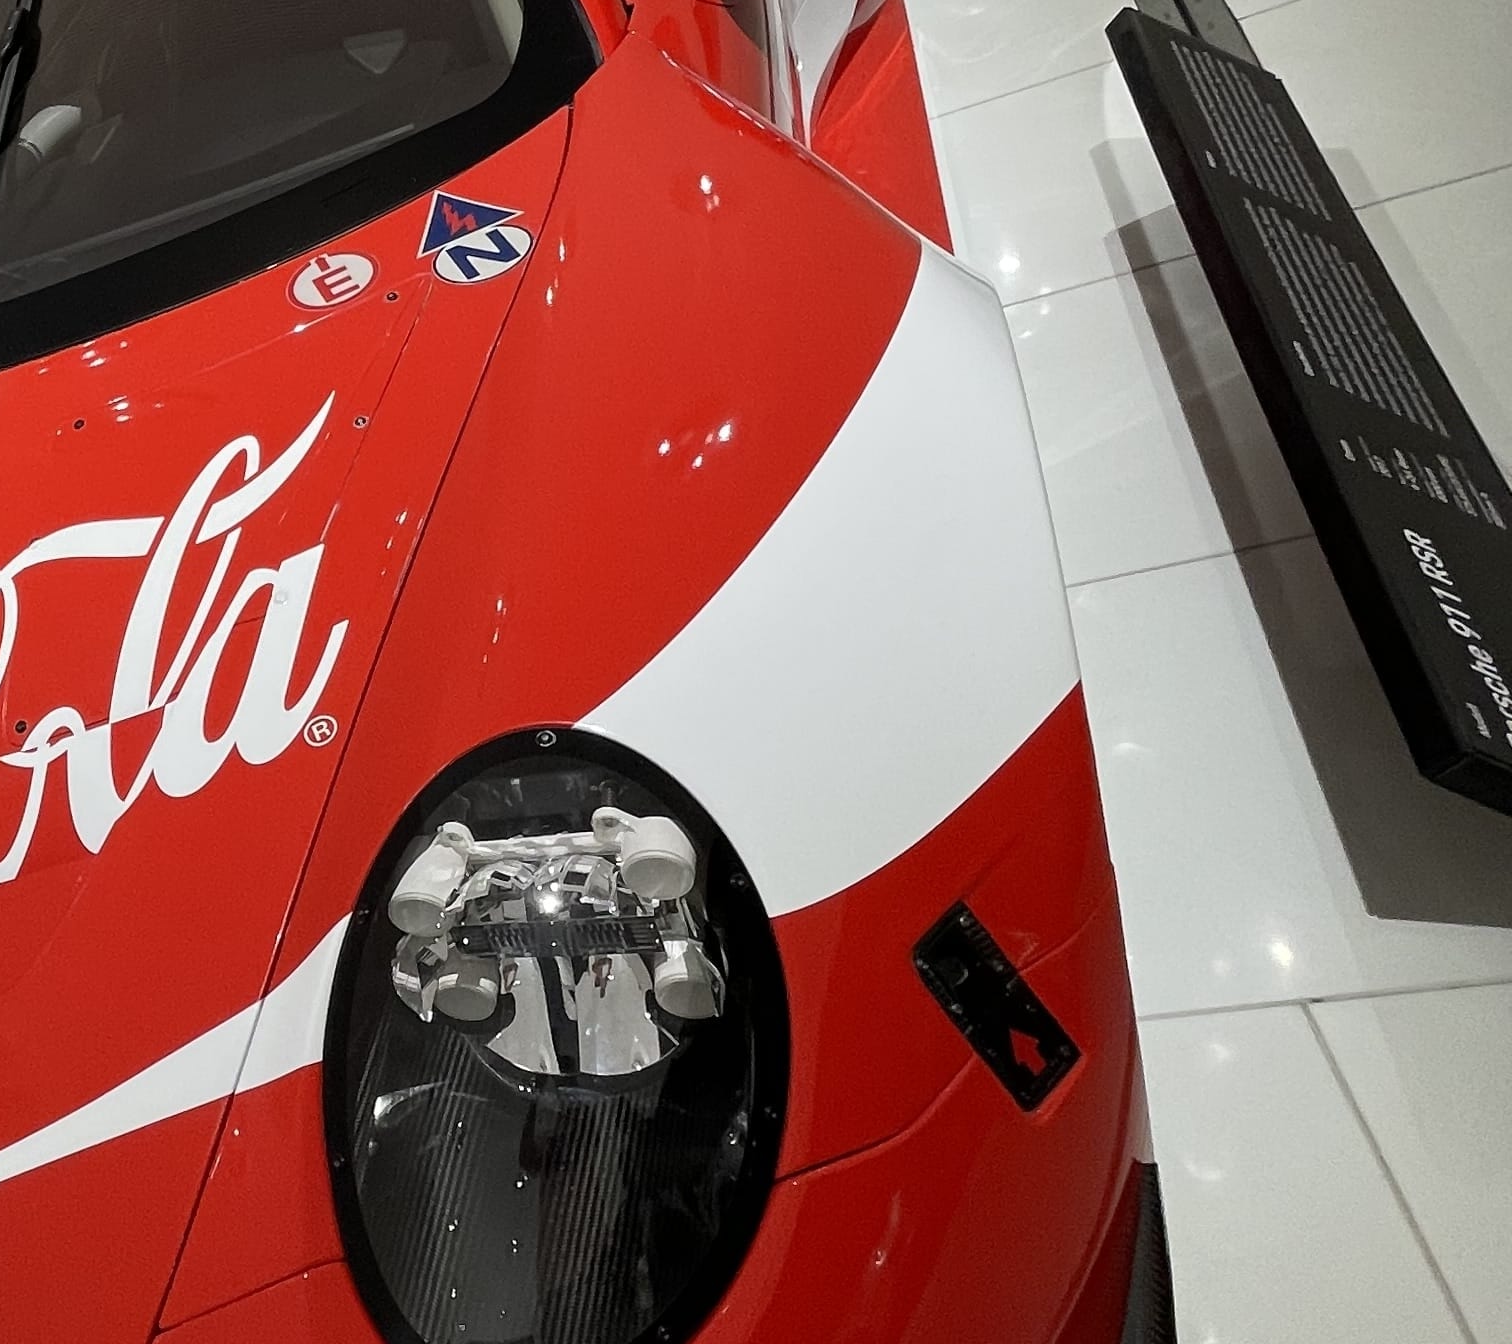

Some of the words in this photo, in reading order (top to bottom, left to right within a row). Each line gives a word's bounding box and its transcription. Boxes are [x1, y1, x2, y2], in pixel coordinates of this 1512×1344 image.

[444, 228, 522, 281] N
[312, 265, 361, 304] E
[1402, 528, 1454, 587] RSR
[1430, 585, 1482, 641] 911
